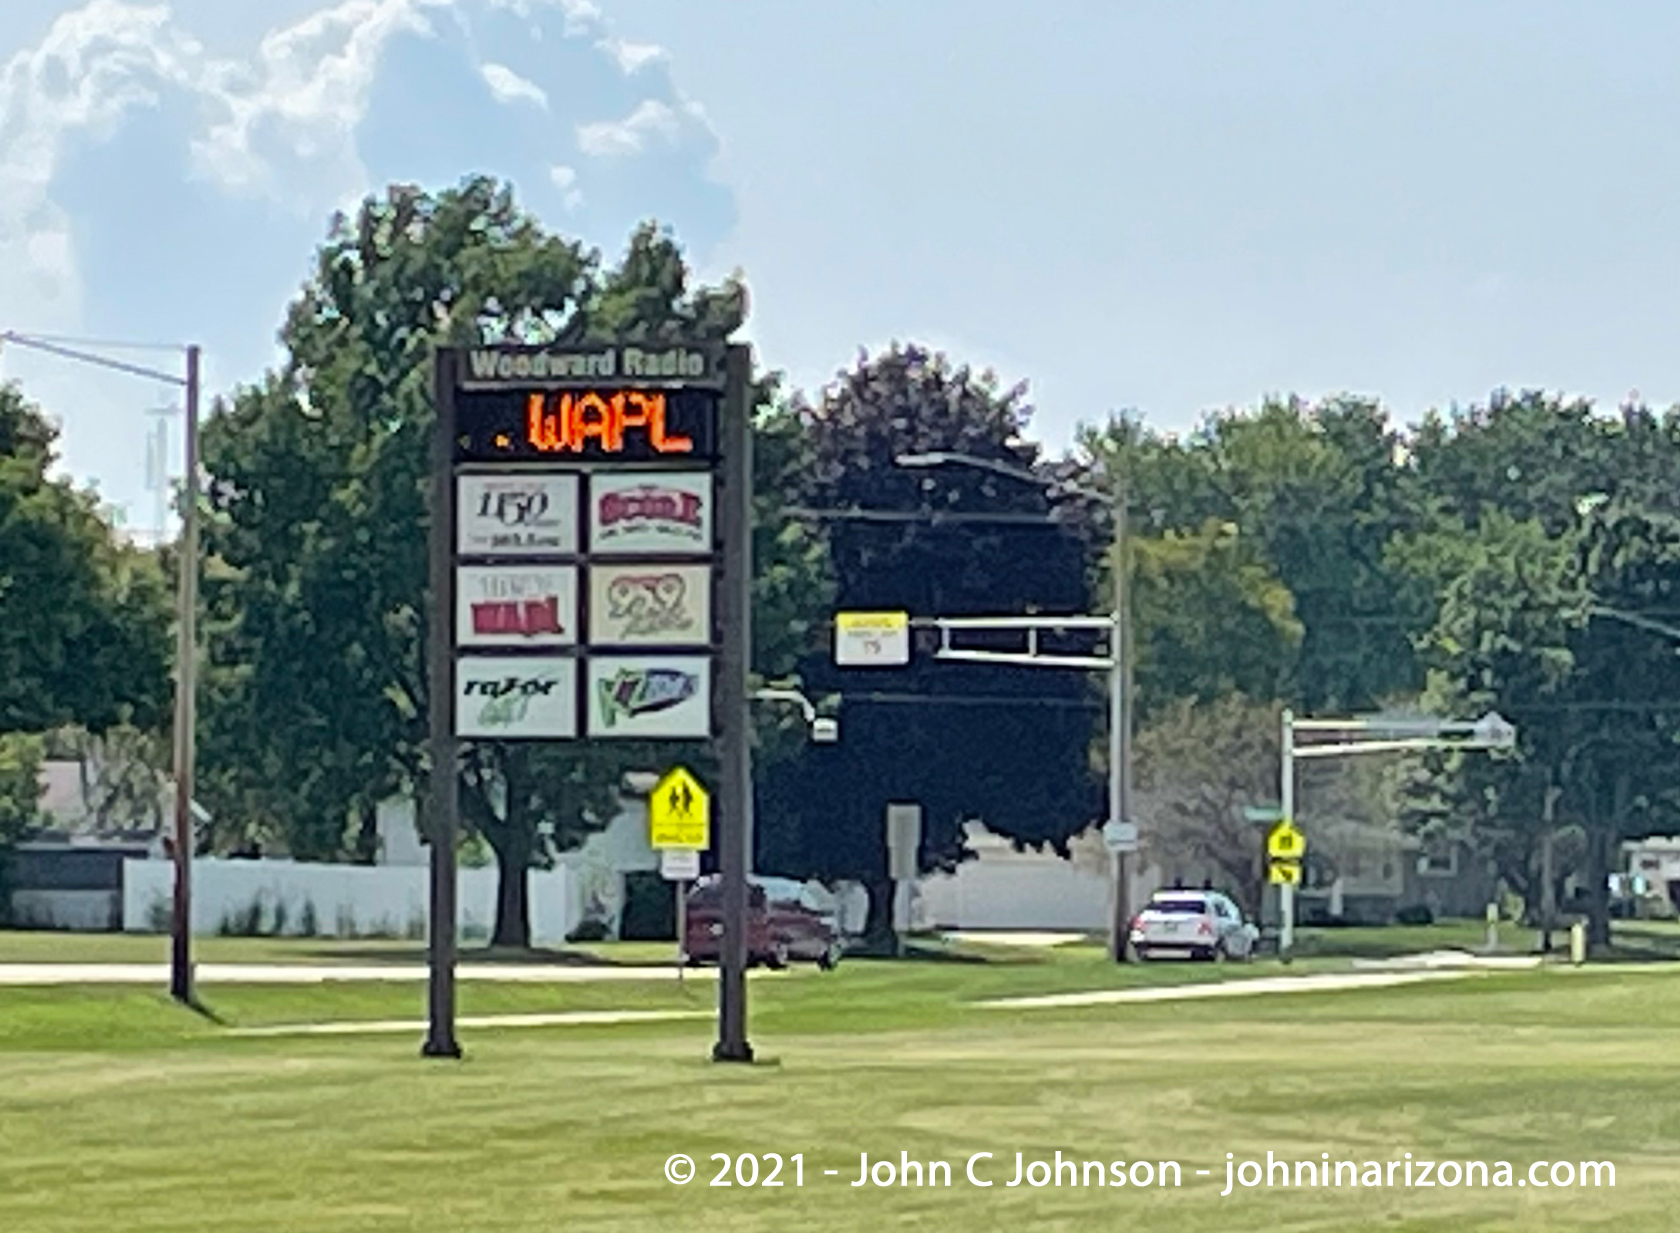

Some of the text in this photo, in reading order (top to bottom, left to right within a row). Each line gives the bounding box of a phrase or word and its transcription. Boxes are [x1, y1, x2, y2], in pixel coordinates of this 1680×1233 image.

[470, 349, 704, 378] Woodward Radio
[528, 391, 694, 453] WAPL
